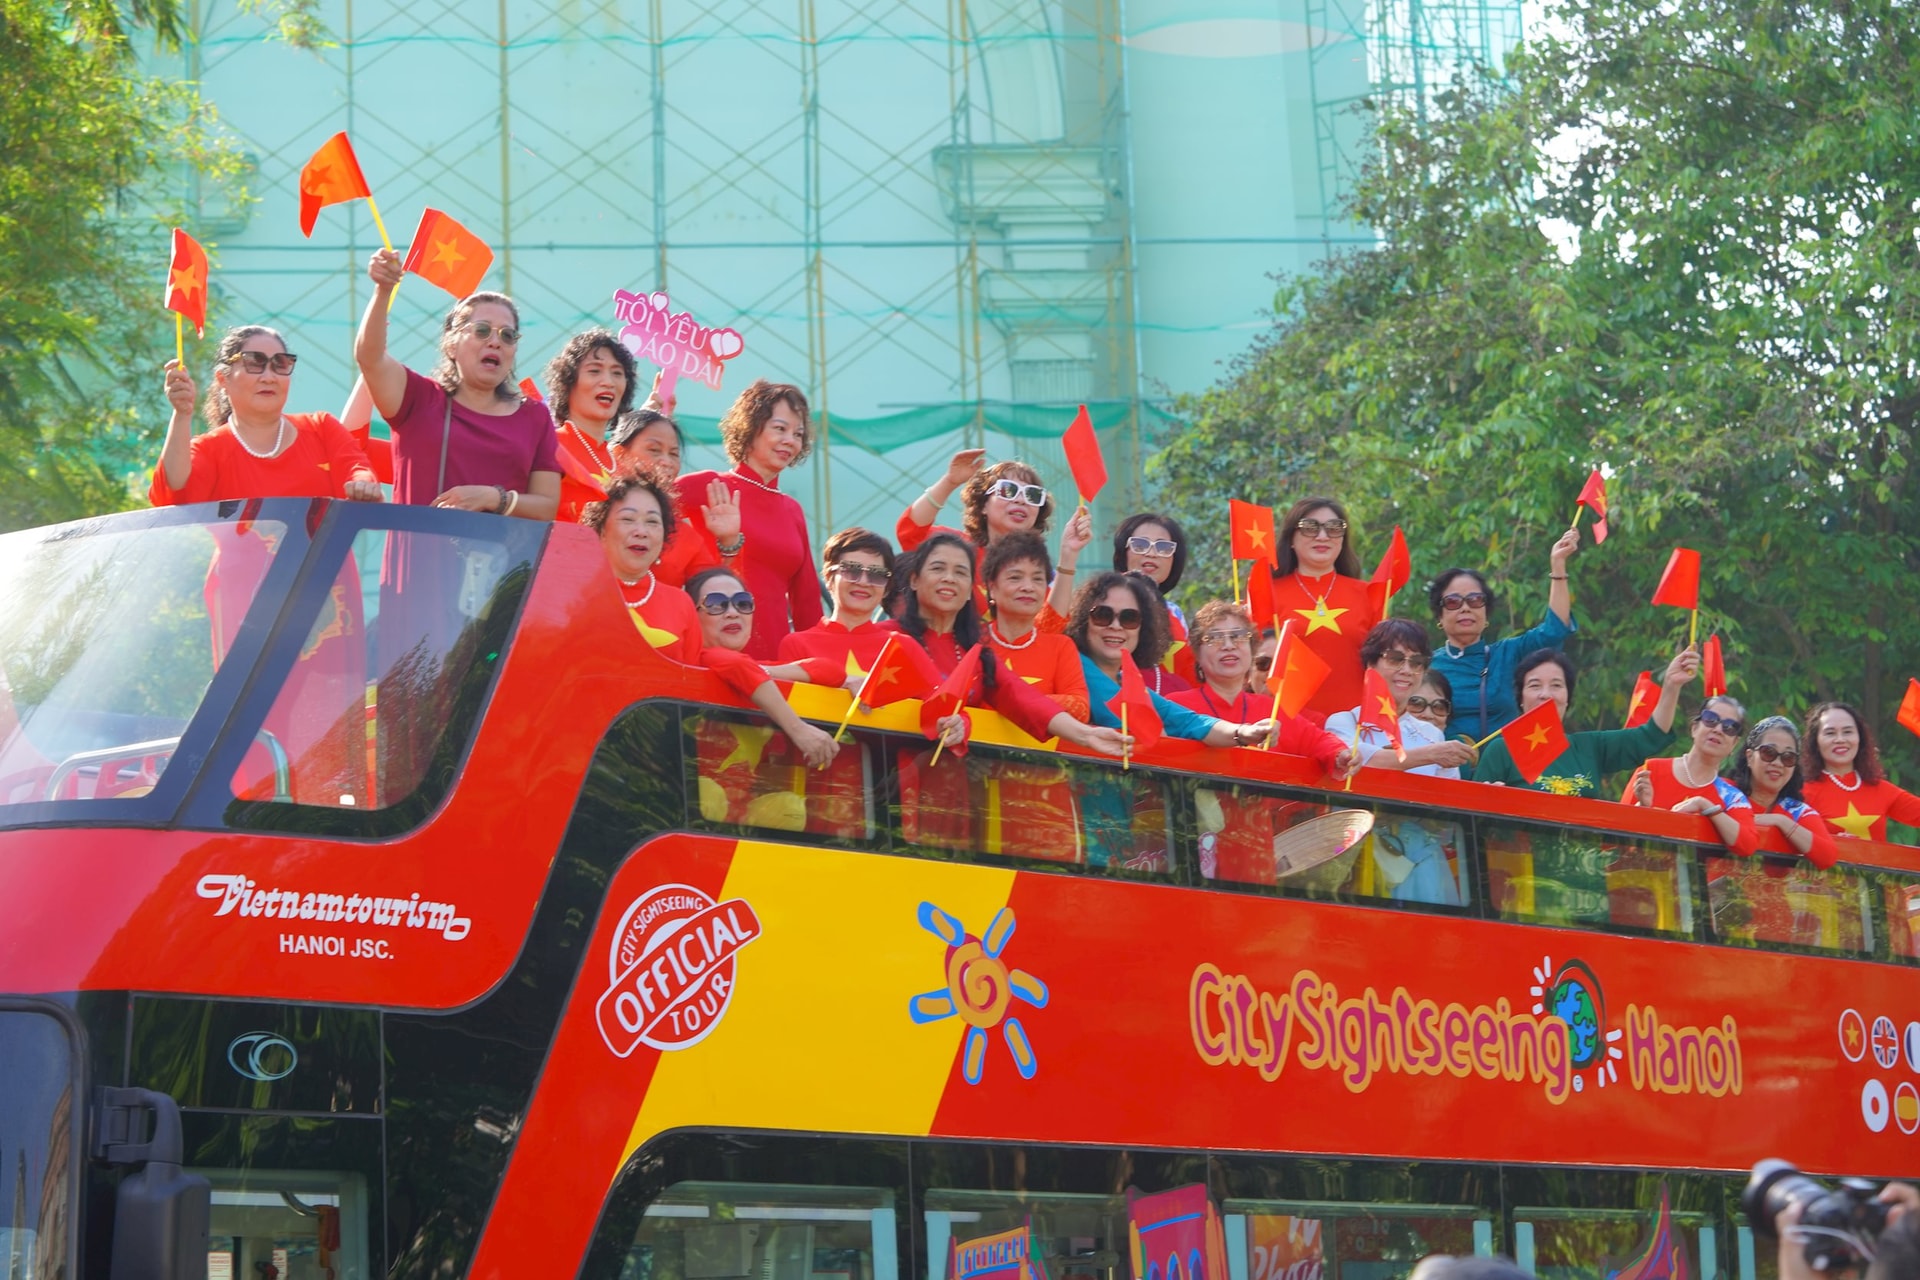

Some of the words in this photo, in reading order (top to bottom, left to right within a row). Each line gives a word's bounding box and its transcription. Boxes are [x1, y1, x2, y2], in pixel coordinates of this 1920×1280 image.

[616, 297, 655, 333] TÔI
[662, 312, 708, 350] YÊU
[641, 332, 677, 366] ÁO
[681, 350, 722, 386] DÀI
[195, 873, 472, 941] Vietnamtourism
[620, 928, 640, 966] CITY
[632, 895, 704, 935] SIGHTSEEING
[279, 933, 345, 957] HANOI
[349, 938, 395, 960] JSC.
[614, 907, 752, 1034] OFFICIAL
[669, 972, 731, 1036] TOUR
[1624, 1001, 1743, 1097] Hanoi
